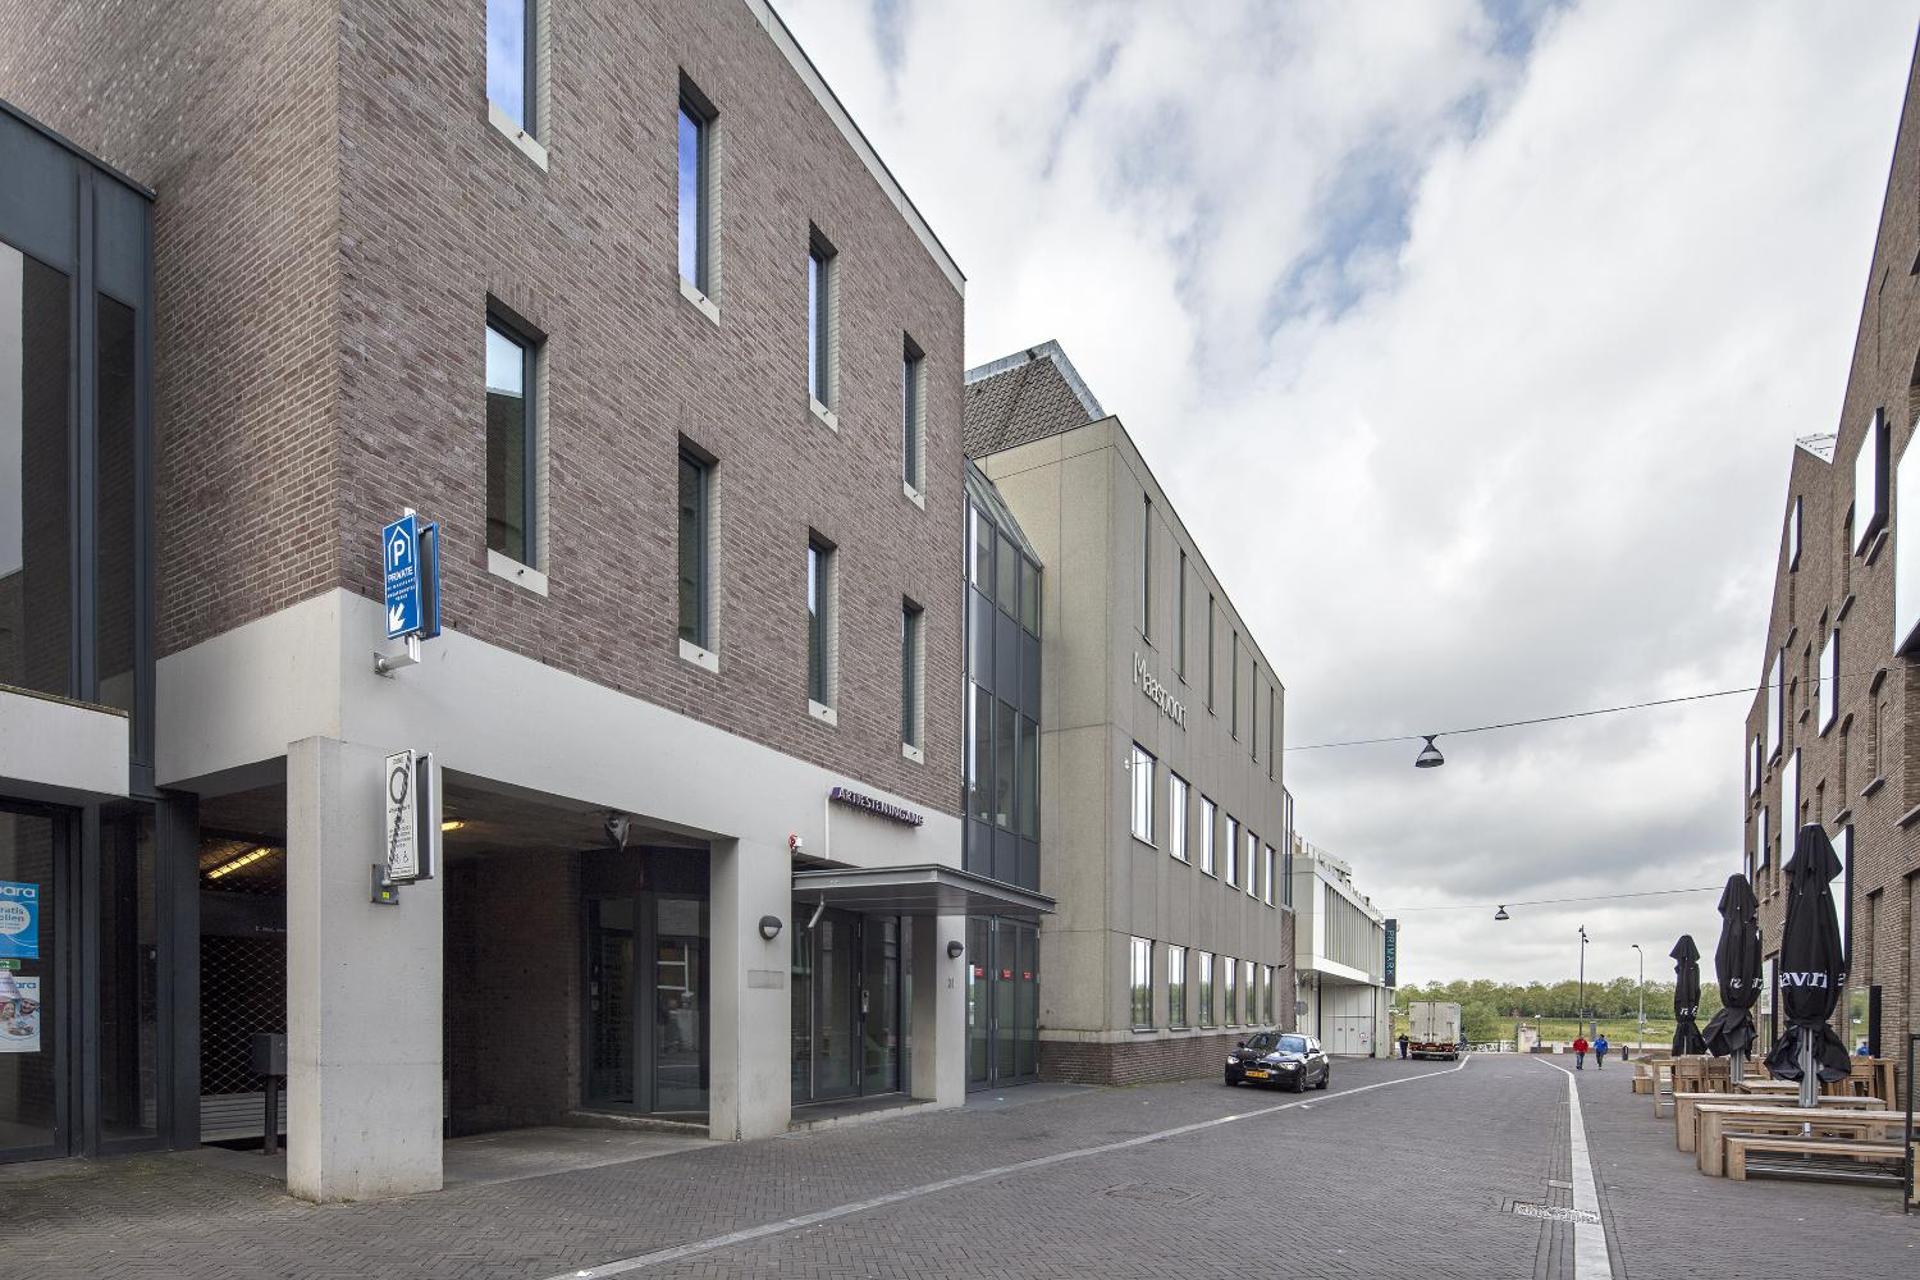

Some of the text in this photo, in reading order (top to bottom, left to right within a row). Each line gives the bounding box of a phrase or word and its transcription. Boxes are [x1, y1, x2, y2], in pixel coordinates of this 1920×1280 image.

[394, 540, 405, 566] P
[387, 565, 414, 582] PRIVATE
[1133, 651, 1187, 732] Maaspoort
[1386, 930, 1395, 975] PRIMARK
